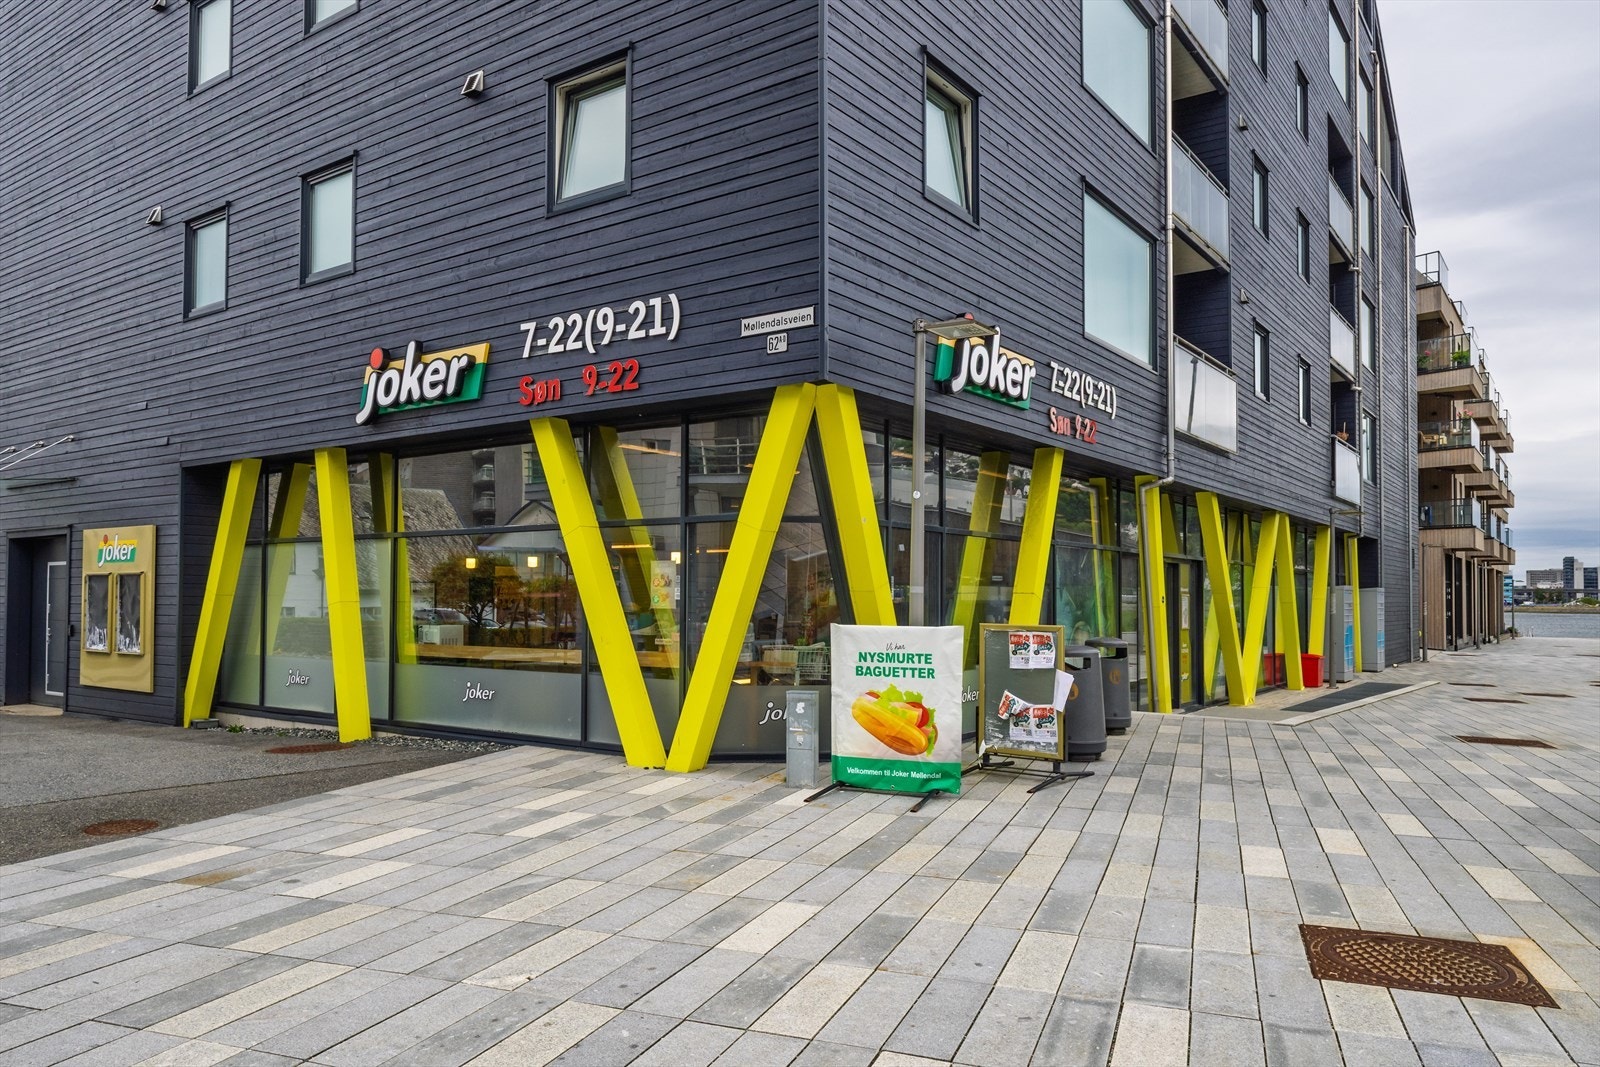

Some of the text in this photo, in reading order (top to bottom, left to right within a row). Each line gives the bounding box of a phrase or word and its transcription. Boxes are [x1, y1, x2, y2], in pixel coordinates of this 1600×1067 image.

[520, 293, 682, 358] 7-22(9-21)
[743, 313, 812, 332] Møllendalsveien
[355, 340, 476, 426] joker
[519, 359, 640, 406] Søn 9-22
[1050, 361, 1117, 420] 7-22(9-21)
[1050, 406, 1097, 444] Søn 9-22
[98, 534, 135, 568] joker
[858, 652, 933, 665] NYSMURTE
[285, 669, 310, 686] joker
[855, 666, 936, 679] BAGUETTER
[463, 681, 495, 702] joker
[961, 685, 979, 703] oker
[846, 767, 882, 776] Velkommen
